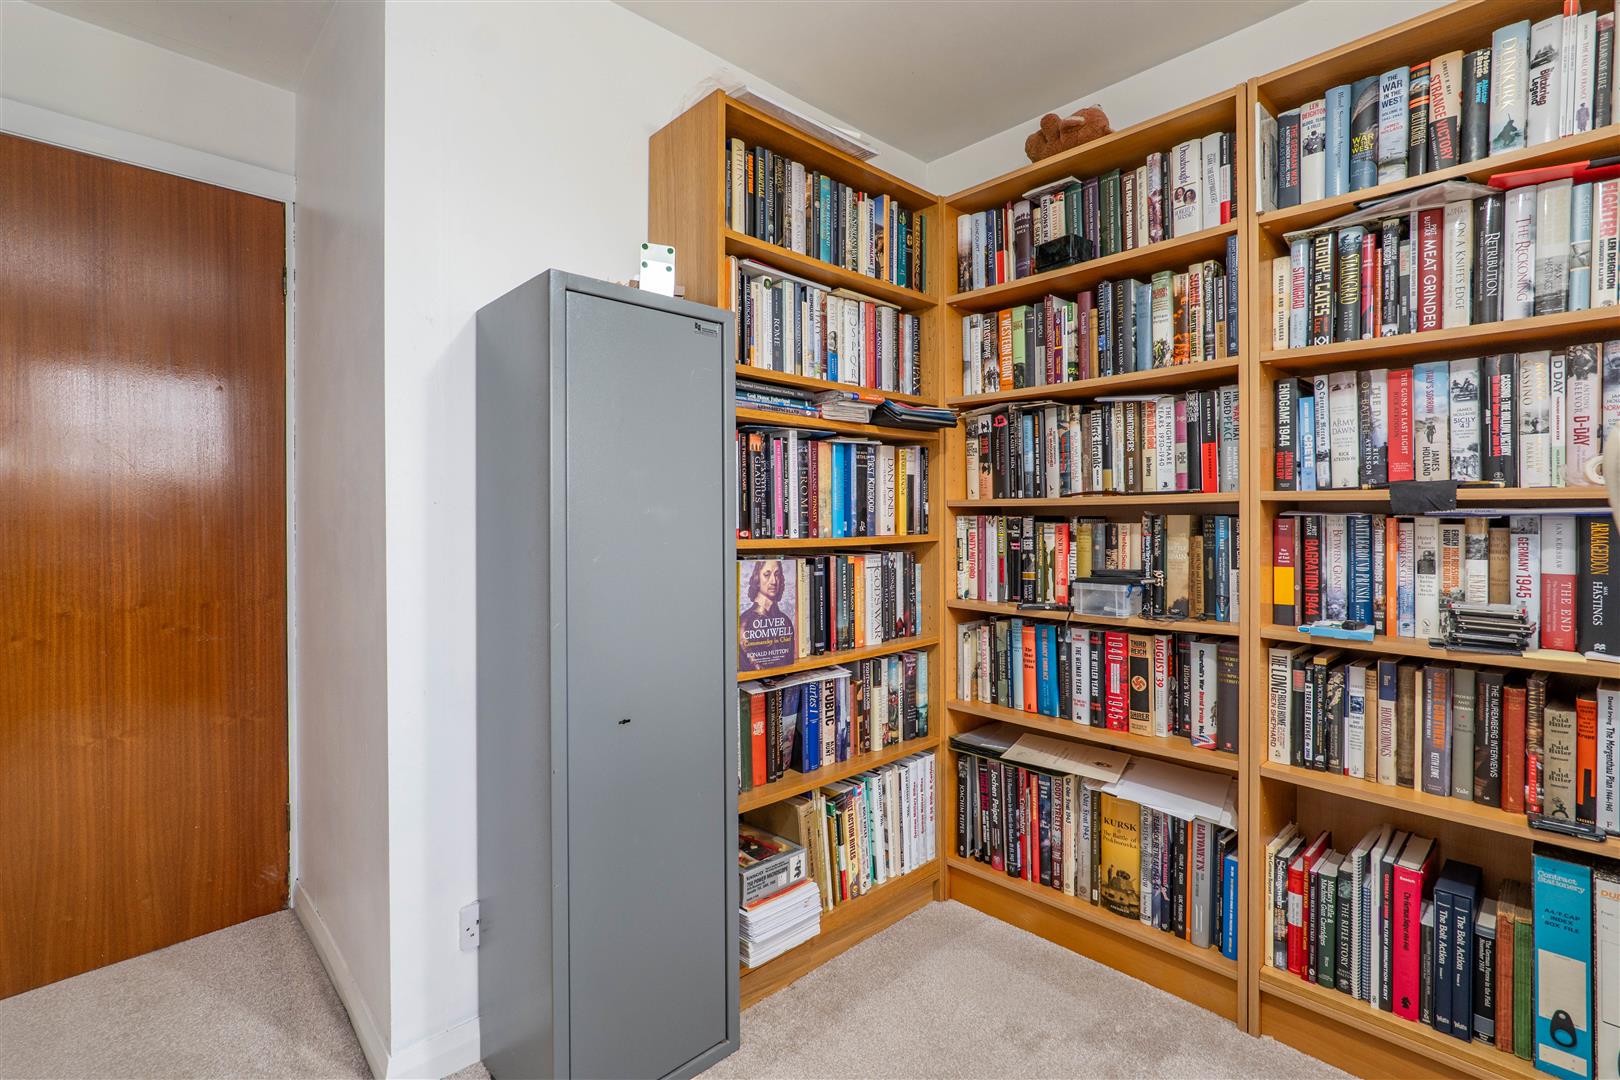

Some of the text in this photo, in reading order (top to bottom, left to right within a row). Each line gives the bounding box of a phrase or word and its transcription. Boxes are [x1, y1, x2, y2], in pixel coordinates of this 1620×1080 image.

[1382, 79, 1404, 93] WAR
[1387, 73, 1398, 81] THE
[1499, 36, 1518, 113] DUNKIRK
[1531, 76, 1540, 106] Legend
[1537, 68, 1551, 107] Blitzkrieg
[1301, 108, 1327, 120] DEIGHTON
[1381, 95, 1404, 109] WEST
[1430, 74, 1454, 160] STRANGE VICTORY
[1179, 143, 1190, 184] Dreadnought
[1600, 181, 1618, 237] FIGHTER
[1485, 231, 1501, 297] RETRIBUTION
[1515, 214, 1532, 302] THE RECKONING
[1606, 237, 1616, 290] LEN DEIGHTON
[1190, 273, 1200, 309] SOMME
[1292, 266, 1305, 310] STALINGRAD
[1340, 253, 1360, 305] STALINGRAD
[1423, 239, 1437, 329] MEAT GRINDER
[983, 319, 991, 359] CATASTROPHE
[1001, 318, 1013, 381] WESTERN FRONT
[1521, 360, 1533, 405] CASSINO
[1553, 360, 1563, 393] D DAY
[1126, 402, 1135, 452] STORMTROOPERS
[1224, 391, 1232, 442] ENDED PEACE
[1279, 383, 1291, 447] ENDGAME 1944
[1400, 372, 1408, 455] THE GUNS AT LAST LIGHT
[1573, 415, 1590, 446] D-DAY
[1092, 411, 1102, 469] Hitler's Heralds
[1304, 434, 1314, 468] CRETE
[1423, 446, 1431, 476] HOLLAND
[1432, 449, 1440, 472] JAMES
[1332, 529, 1342, 594] BETWEEN GIANTS
[1355, 519, 1370, 603] BATTLEGROUND PRUSSIA
[1516, 536, 1532, 599] GERMANY 1945
[1590, 522, 1609, 575] ARMAGEDDON
[1153, 570, 1164, 587] 1933
[1304, 539, 1319, 616] BAGRATION 1944
[753, 617, 785, 629] OLIVER
[1561, 582, 1571, 632] THE END
[1592, 581, 1603, 626] HASTINGS
[743, 627, 793, 640] CROMWELL
[744, 639, 773, 647] Commander
[747, 648, 790, 658] RONALD HUTTON
[1108, 637, 1123, 661] 1940
[1130, 647, 1147, 655] REICH
[1155, 638, 1164, 674] AUGUST
[824, 679, 834, 727] EPUBLIC
[1091, 680, 1099, 697] YEARS
[1108, 695, 1123, 720] 1945
[1271, 655, 1287, 727] THE LONG ROAD HOME
[1130, 711, 1150, 720] SHIRER
[1380, 706, 1392, 758] HOMECOMINGS
[1490, 685, 1499, 778] THE NUREMBERG INTERVIEWS
[1548, 721, 1572, 729] Hitler
[1548, 748, 1572, 756] Hitler
[1548, 776, 1572, 784] Hitler
[1103, 816, 1137, 832] KURSK
[753, 875, 767, 885] POWER
[1537, 870, 1578, 886] Contract
[1439, 910, 1448, 964] The Bolt Action
[1550, 915, 1573, 926] INDEX
[1340, 942, 1349, 967] STORY
[1456, 916, 1466, 970] The Bolt Action
